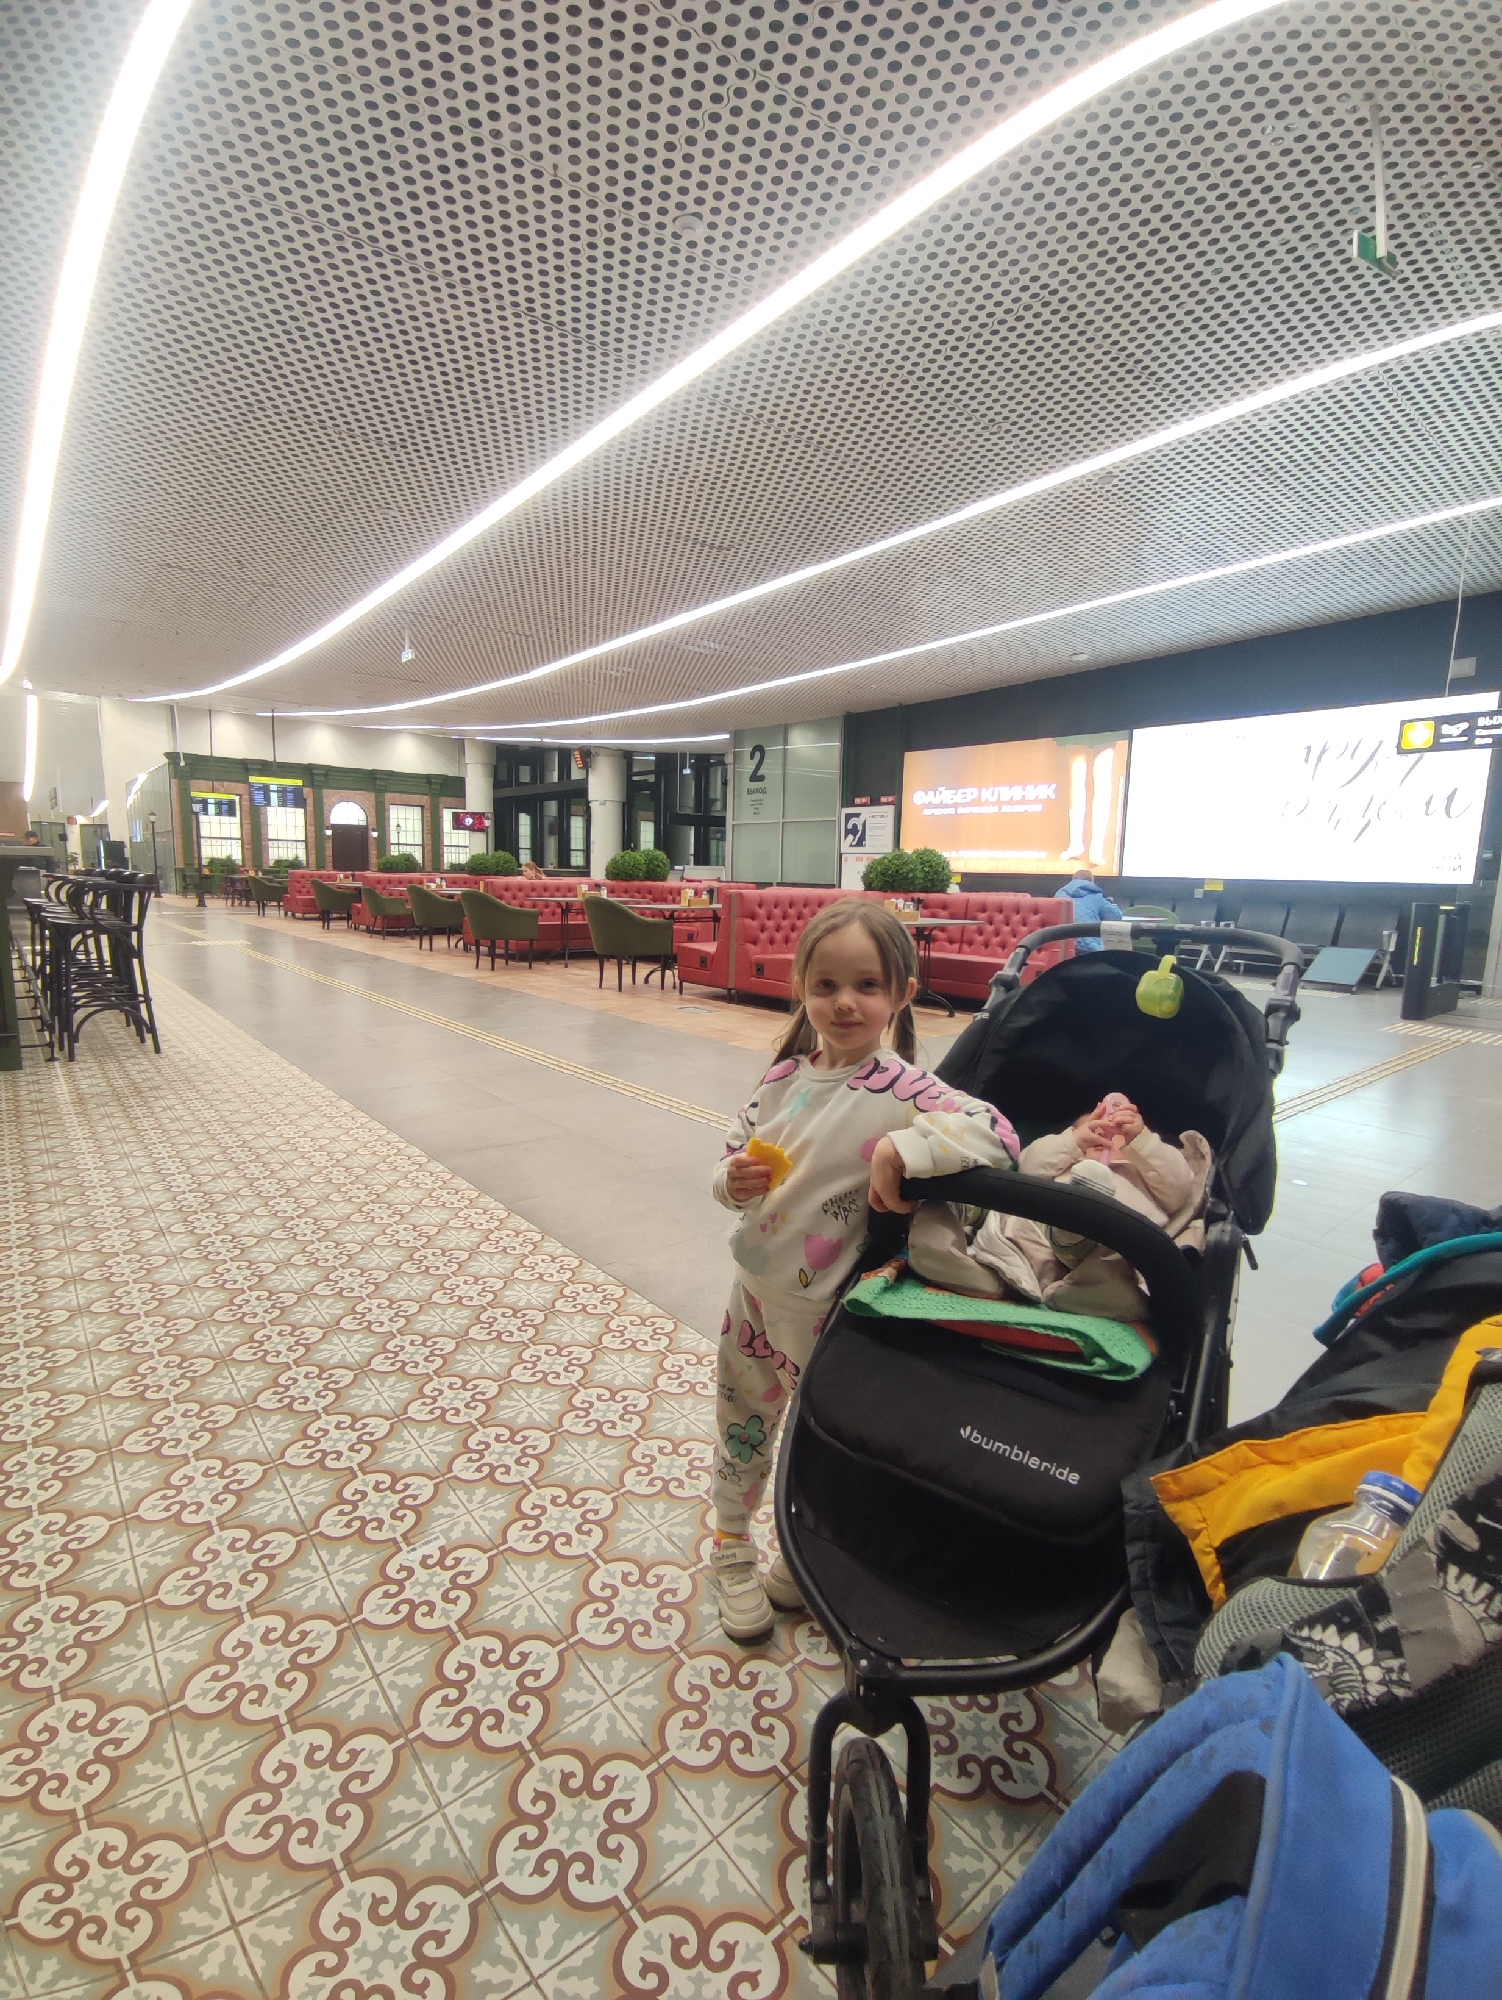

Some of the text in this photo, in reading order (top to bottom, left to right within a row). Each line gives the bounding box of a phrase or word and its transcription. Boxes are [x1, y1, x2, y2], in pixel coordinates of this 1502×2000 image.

[749, 744, 766, 782] 2
[746, 786, 768, 796] ВЫХОД
[912, 783, 1057, 805] ФАЙБЕР КЛИНИК
[969, 1429, 1081, 1485] bumbleride
